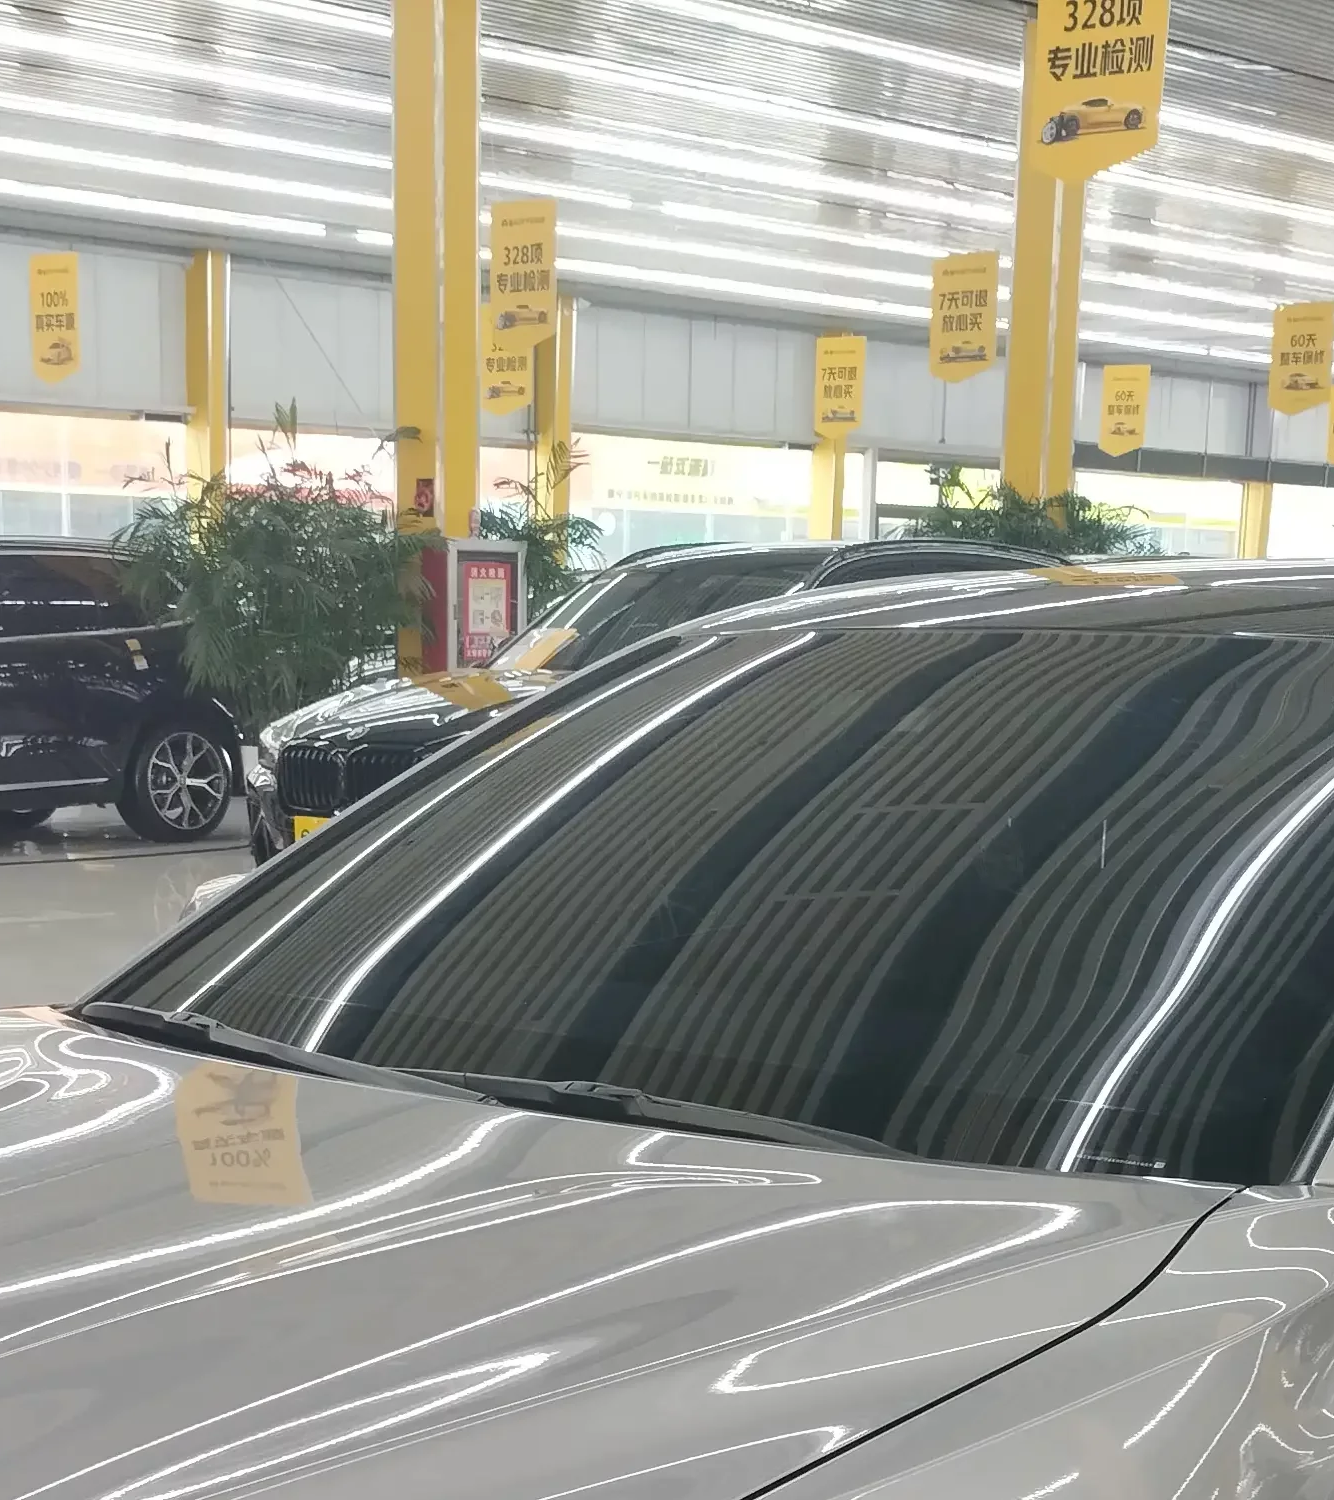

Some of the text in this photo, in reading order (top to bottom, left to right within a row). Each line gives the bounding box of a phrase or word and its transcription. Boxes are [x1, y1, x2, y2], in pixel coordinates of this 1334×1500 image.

[1047, 34, 1155, 82] 专业检测
[503, 242, 544, 267] 328项
[496, 269, 551, 294] 专业检测
[39, 290, 69, 308] 100%
[938, 289, 989, 311] 7天可退
[941, 312, 983, 333] 放心买
[1290, 333, 1318, 349] 60天
[821, 366, 858, 382] 7天可退
